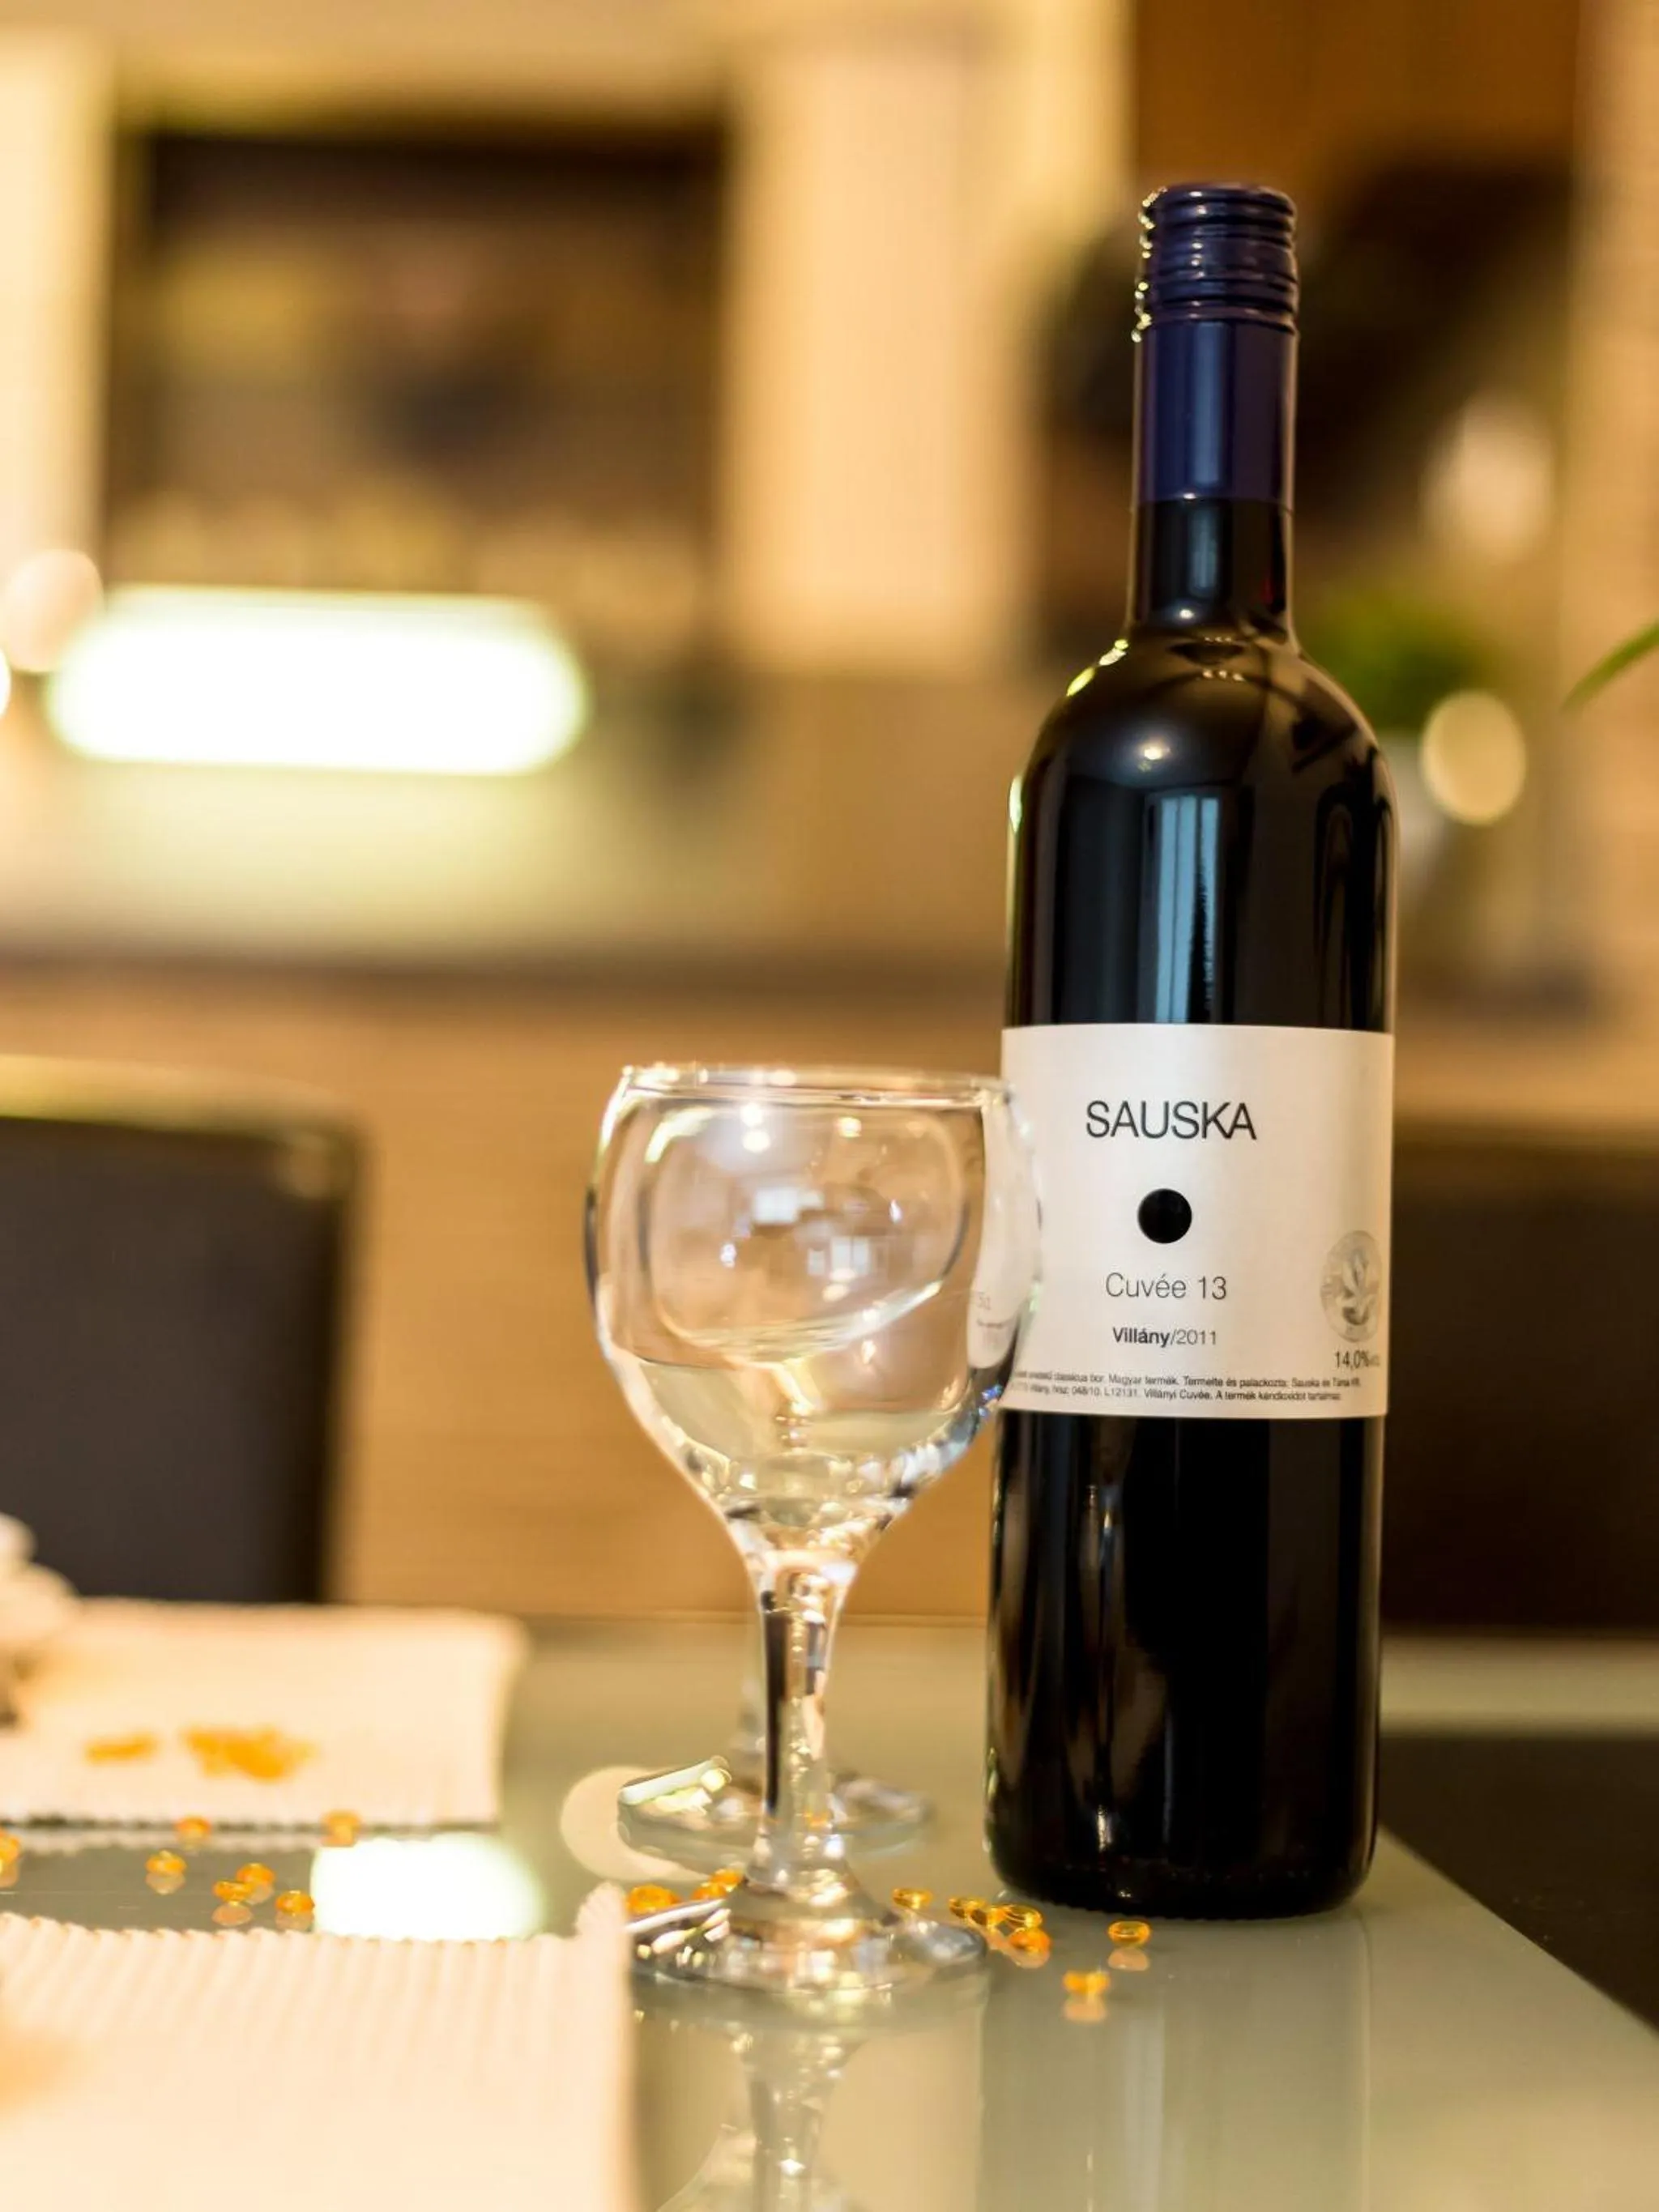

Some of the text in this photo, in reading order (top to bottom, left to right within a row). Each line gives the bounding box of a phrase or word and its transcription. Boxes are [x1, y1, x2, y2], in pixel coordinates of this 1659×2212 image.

[1086, 1099, 1256, 1140] SAUSKA
[1105, 1272, 1227, 1300] Cuvée 13
[1112, 1325, 1217, 1348] Villány/2011
[1108, 1373, 1142, 1387] Magyar
[1183, 1375, 1223, 1387] Termelte
[1226, 1376, 1237, 1387] és
[1292, 1377, 1320, 1387] Sauska
[1144, 1388, 1177, 1401] Villányi
[1216, 1389, 1223, 1400] A
[1226, 1391, 1256, 1401] termék
